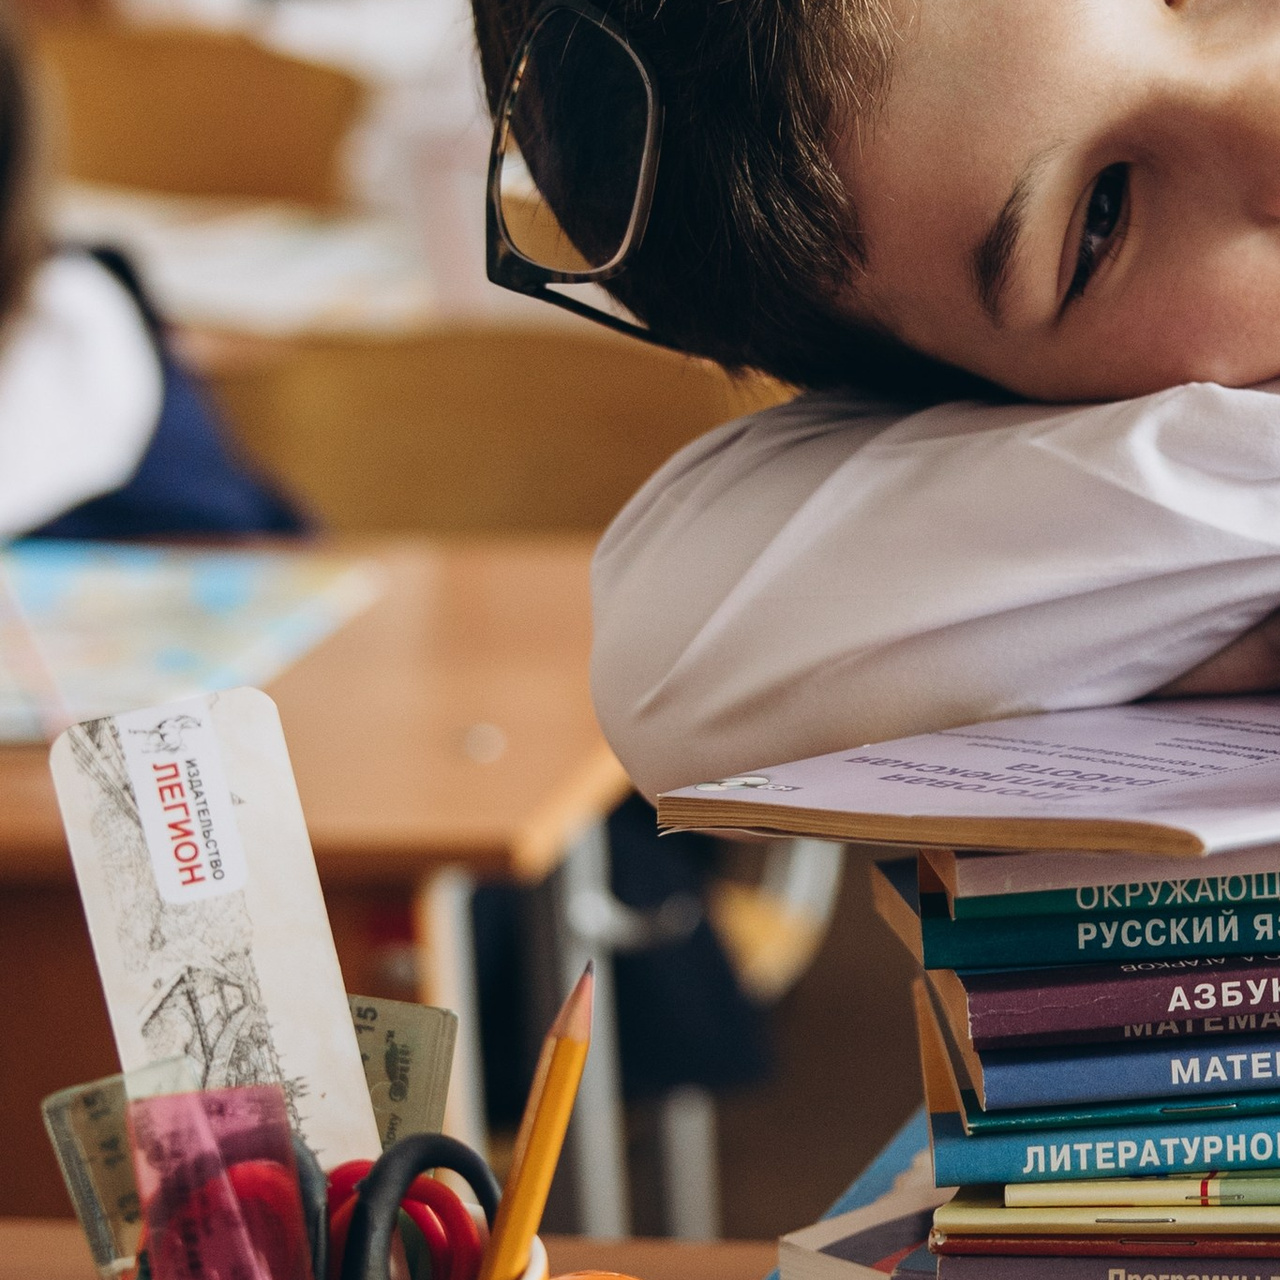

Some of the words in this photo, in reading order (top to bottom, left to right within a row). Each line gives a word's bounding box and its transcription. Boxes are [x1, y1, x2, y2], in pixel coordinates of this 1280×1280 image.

[842, 755, 1126, 794] комплексная
[876, 772, 1083, 802] Итоговая
[1004, 762, 1171, 788] работа
[152, 760, 208, 888] ЛЕГИОН
[183, 757, 226, 882] ИЗДАТЕЛЬСТВО
[1076, 908, 1240, 950] РУССКИЙ
